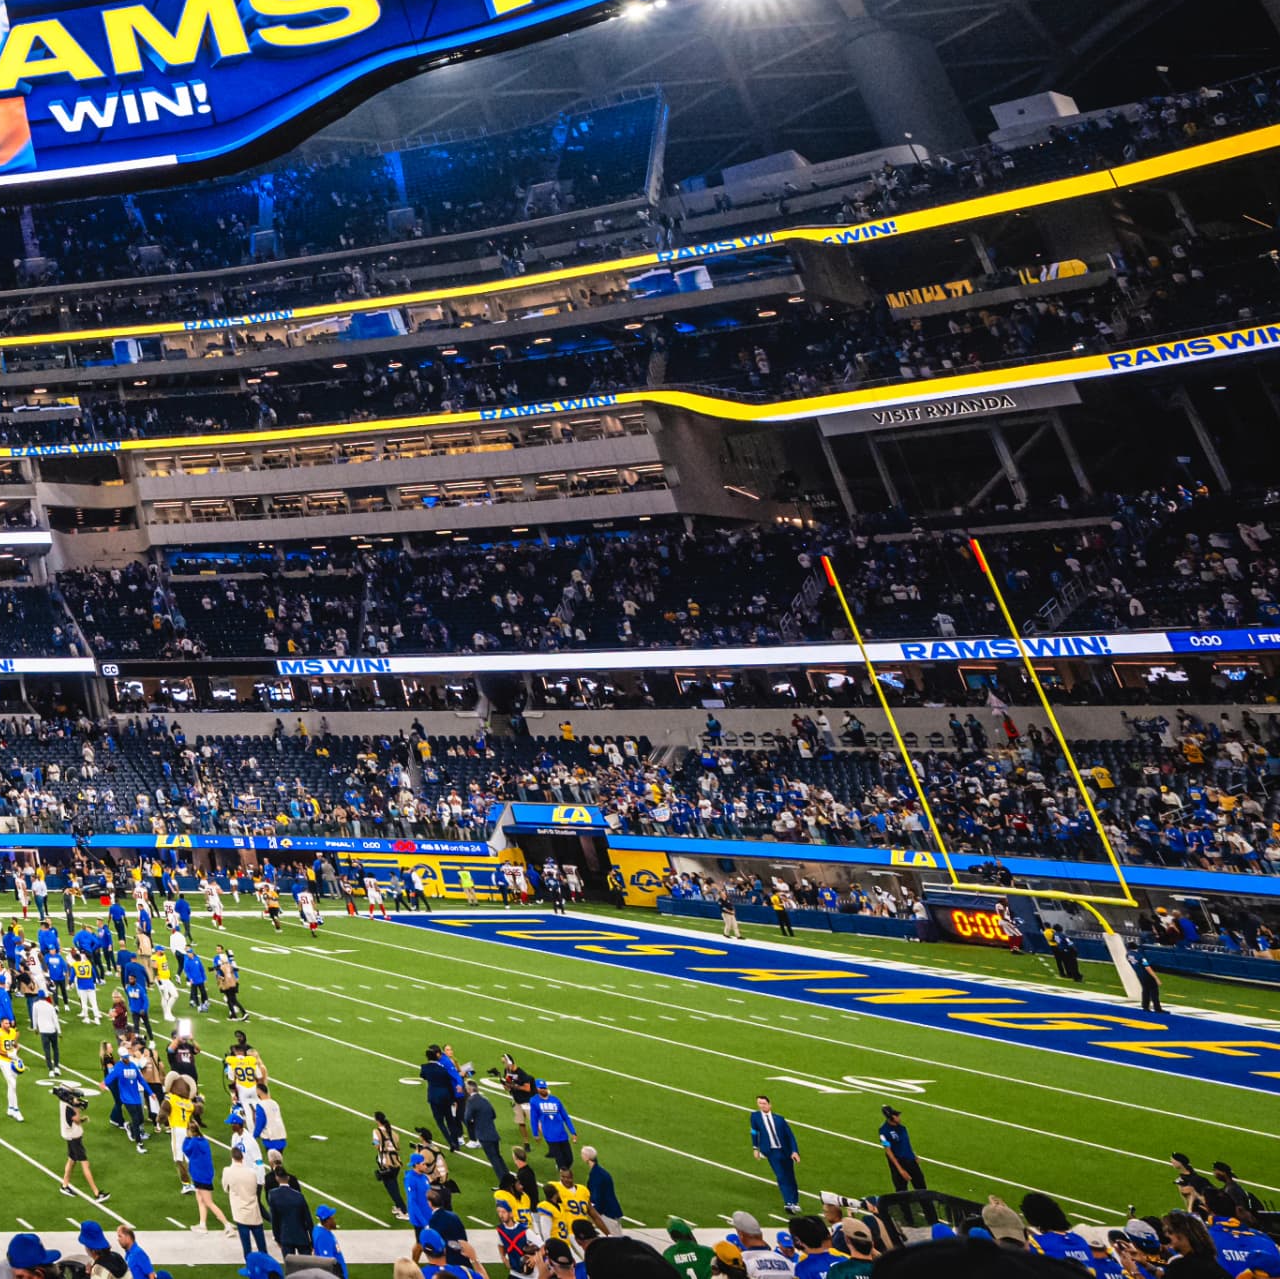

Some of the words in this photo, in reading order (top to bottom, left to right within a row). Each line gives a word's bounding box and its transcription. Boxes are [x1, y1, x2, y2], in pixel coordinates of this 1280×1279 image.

[48, 80, 210, 133] WIN!
[1110, 340, 1215, 369] RAMS
[481, 402, 567, 420] RAMS
[566, 395, 615, 410] WIN!
[873, 406, 921, 426] VISIT
[927, 394, 1016, 419] RWANDA
[11, 445, 71, 456] RAMS
[77, 442, 120, 452] WIN!
[900, 639, 1020, 661] RAMS
[1018, 636, 1114, 657] WIN!
[1190, 634, 1222, 648] 0:00
[104, 666, 117, 674] CC
[328, 658, 391, 673] WIN!
[687, 966, 1280, 1078] ANGE
[235, 1067, 253, 1081] 99
[766, 1074, 925, 1094] 10
[566, 1199, 589, 1216] 90
[674, 1252, 698, 1265] HURTS
[755, 1258, 789, 1271] JACKSON
